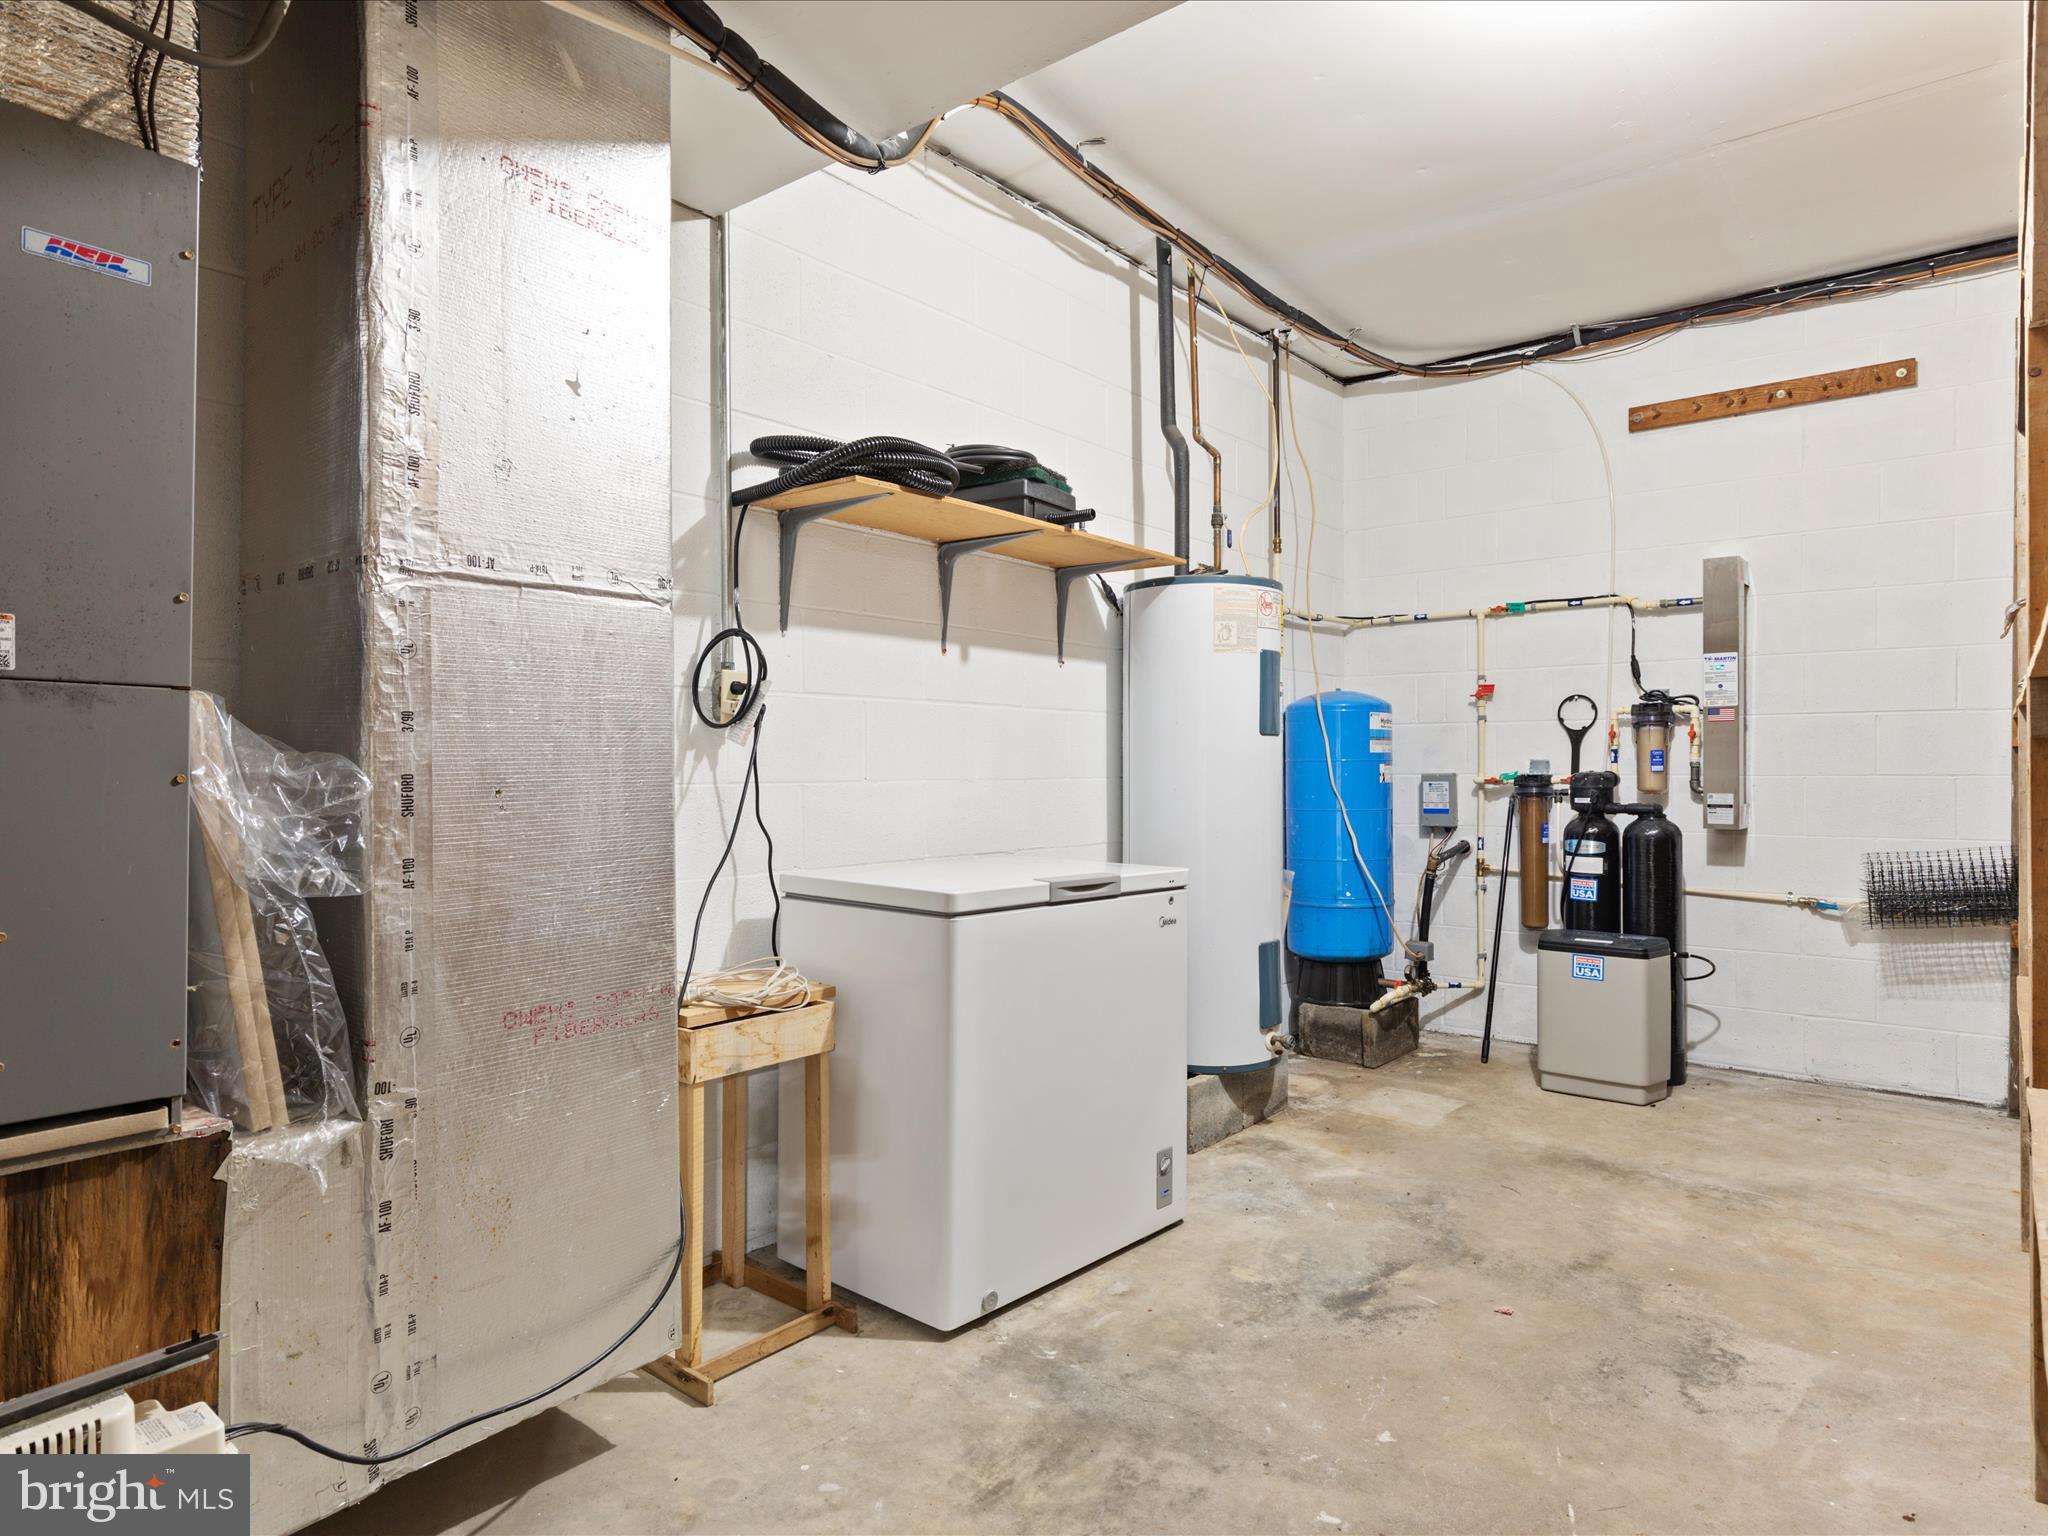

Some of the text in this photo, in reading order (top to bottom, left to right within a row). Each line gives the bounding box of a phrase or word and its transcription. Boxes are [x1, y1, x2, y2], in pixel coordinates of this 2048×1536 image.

[404, 0, 418, 28] SHUF
[406, 65, 419, 101] AF-100
[45, 238, 129, 274] HEIL
[408, 308, 421, 332] 3/90
[408, 371, 421, 417] SHUFORD
[407, 455, 420, 489] AF-100
[466, 555, 495, 570] AF-100
[400, 710, 414, 733] 3/90
[401, 773, 414, 817] SHUFORD
[402, 857, 415, 889] AF-100
[1573, 889, 1593, 898] USA
[1576, 967, 1600, 977] USA
[378, 1200, 392, 1233] AF-100
[379, 1273, 389, 1297] 181A-P
[407, 1313, 417, 1337] 181A-P
